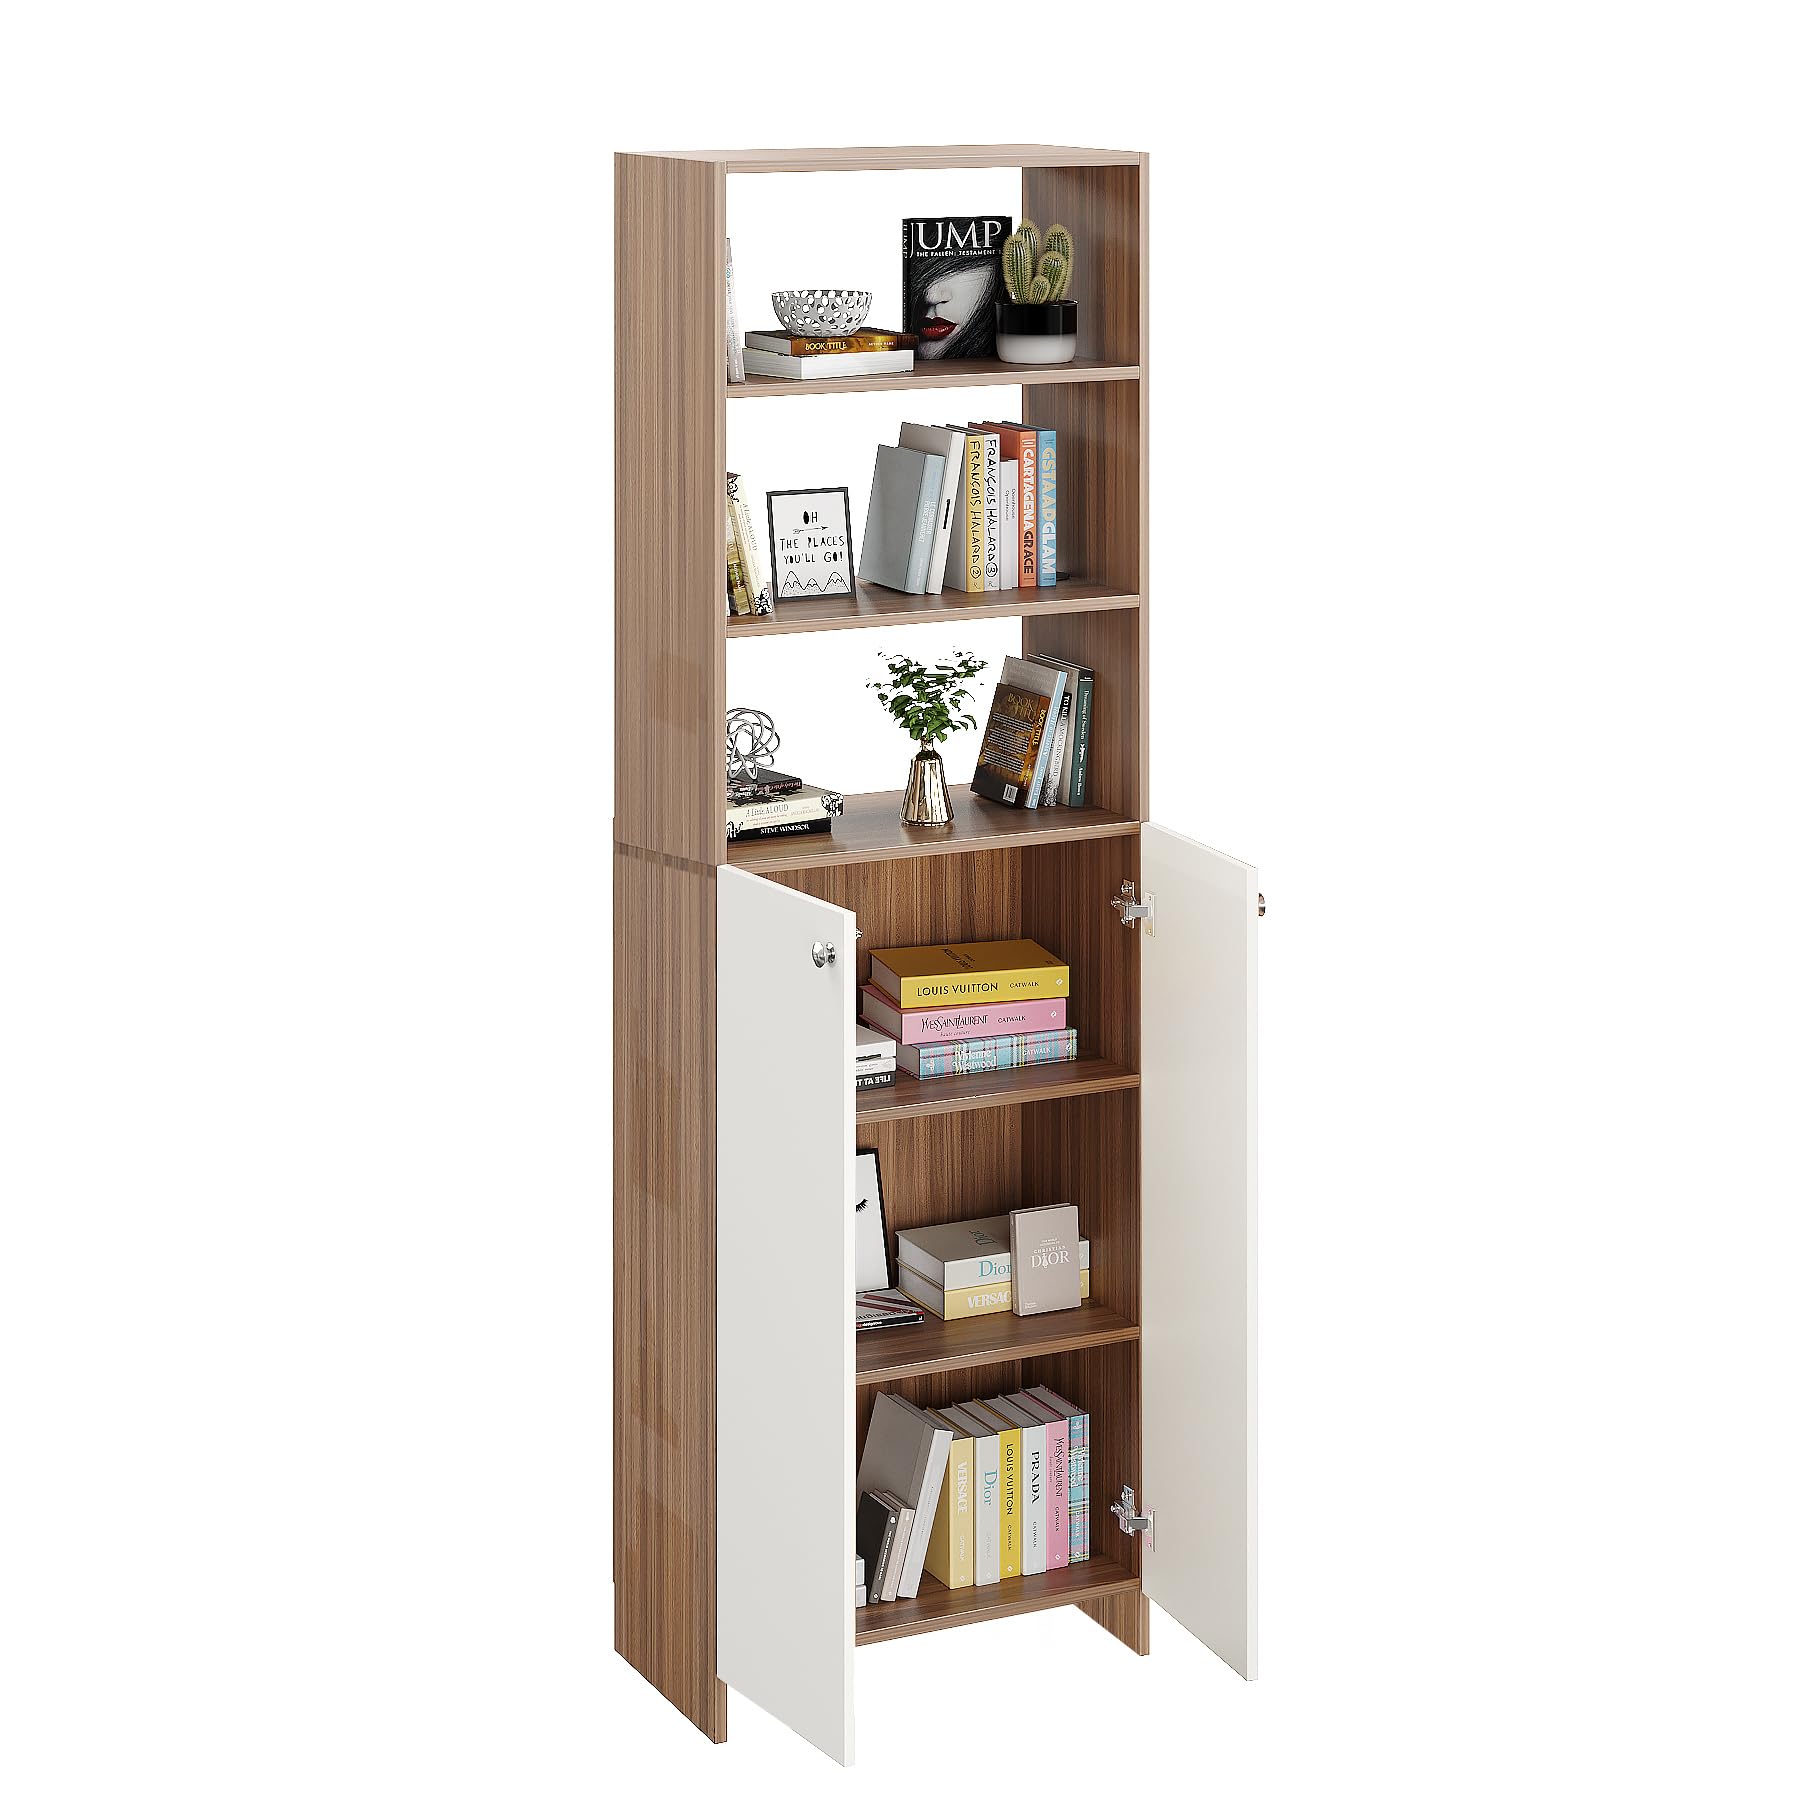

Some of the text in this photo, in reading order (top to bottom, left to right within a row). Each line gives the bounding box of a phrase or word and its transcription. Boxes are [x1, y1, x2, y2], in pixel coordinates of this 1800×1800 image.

[910, 220, 1002, 258] JUMP
[805, 342, 827, 351] BOOK
[827, 341, 848, 351] TITLE
[803, 510, 818, 524] OH
[970, 510, 982, 564] HALARD
[986, 508, 997, 562] HALARD
[780, 536, 845, 551] THE PLACES
[784, 551, 843, 564] YOU'LL GO!
[1063, 695, 1071, 706] TO
[1061, 706, 1069, 721] KILL
[760, 824, 810, 835] STEVE WINDSOR
[917, 981, 1039, 997] LOUIS VUITTON CATWALK
[997, 1015, 1026, 1024] CATWALK
[1023, 1048, 1051, 1056] CATWALK
[1033, 1245, 1066, 1254] CHRISTIAN
[978, 1260, 1012, 1277] Dior
[967, 1290, 1012, 1309] VERSAC
[1031, 1451, 1040, 1504] PRADA
[957, 1461, 968, 1515] VERSACE
[983, 1469, 998, 1506] Dior
